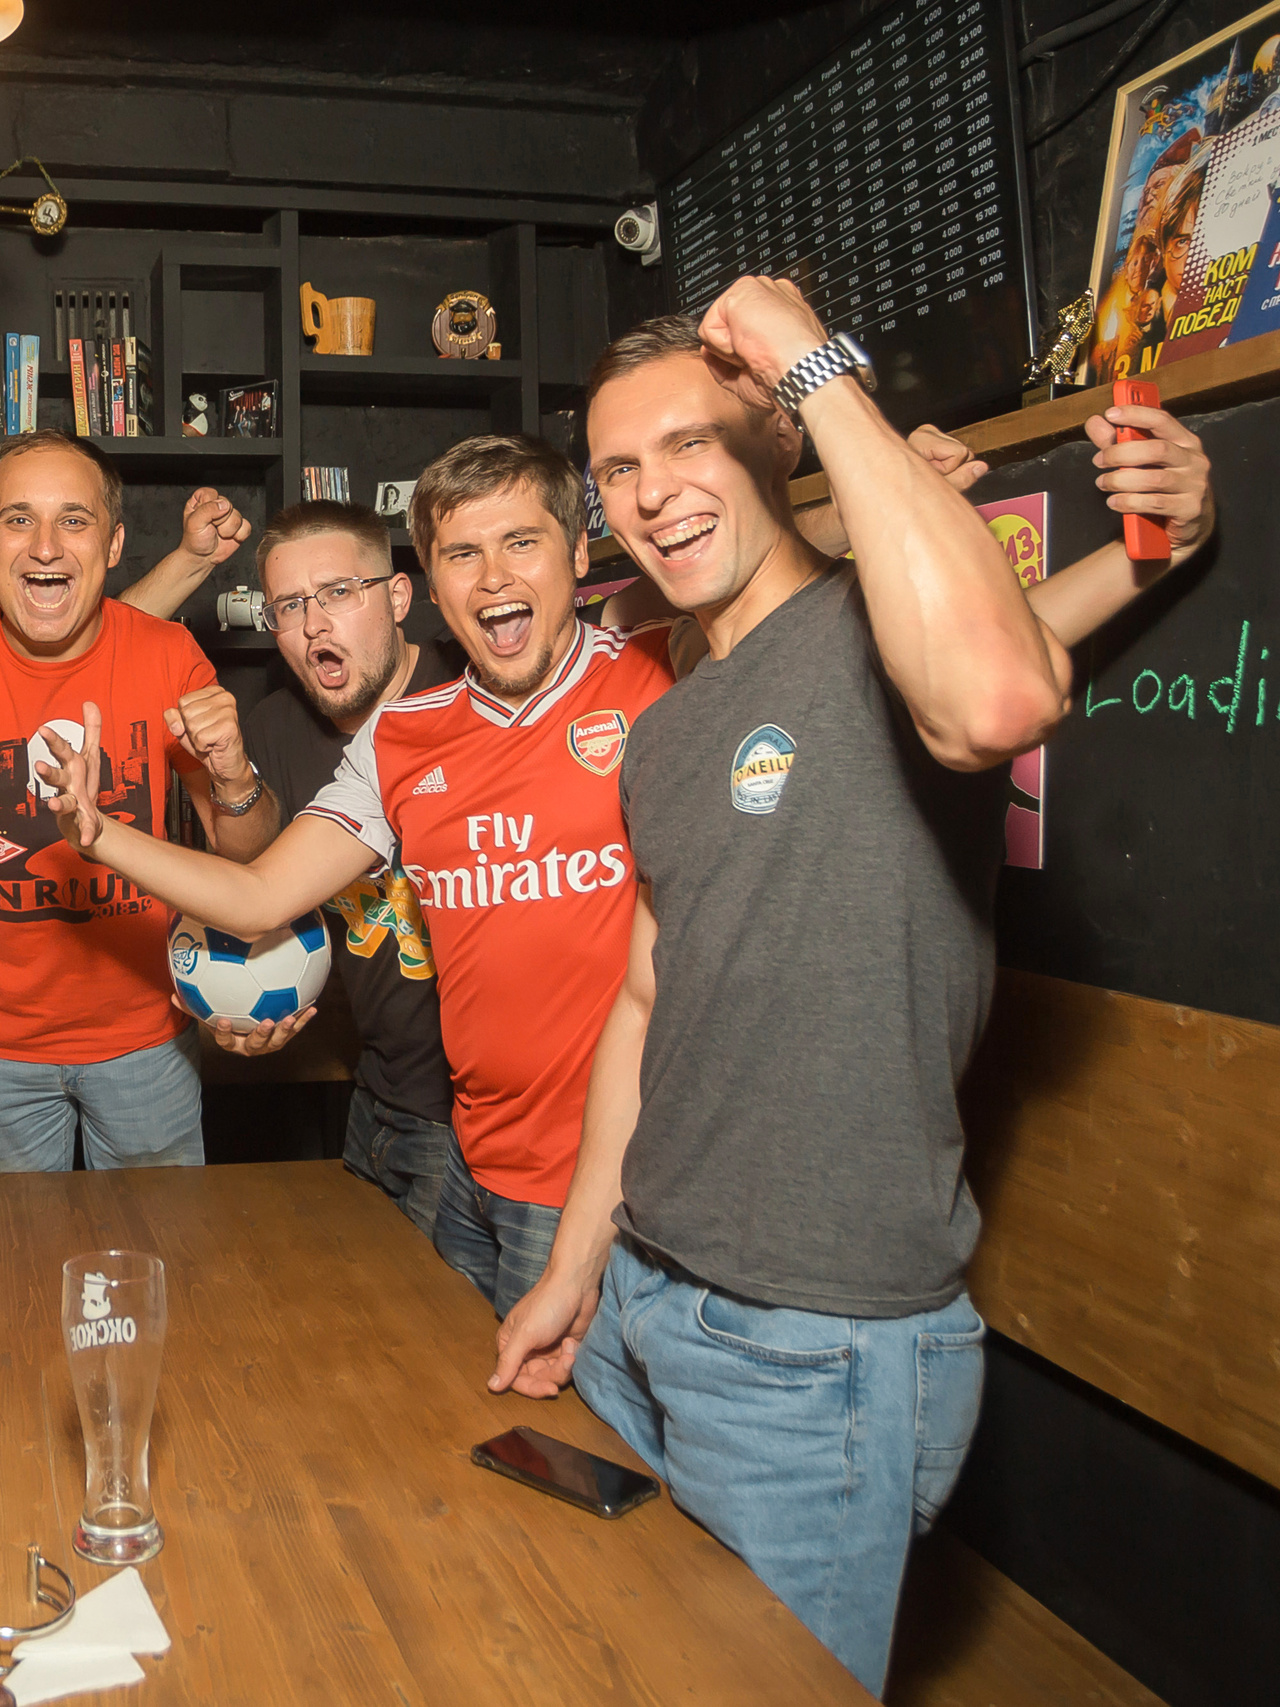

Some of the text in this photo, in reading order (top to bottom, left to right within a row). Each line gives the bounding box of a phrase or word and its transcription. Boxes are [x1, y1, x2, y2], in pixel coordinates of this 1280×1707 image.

[881, 16, 900, 35] Раунд
[850, 41, 868, 59] Раунд
[821, 65, 837, 82] Раунд
[793, 87, 808, 103] Раунд
[802, 101, 814, 114] -100
[810, 120, 815, 130] 0
[1251, 125, 1280, 147] 1 МЕС
[812, 139, 817, 148] 0
[902, 137, 915, 152] 800
[806, 158, 818, 171] -300
[809, 176, 820, 190] 200
[811, 195, 822, 207] 400
[811, 214, 824, 227] -300
[909, 220, 922, 234] 300
[814, 232, 825, 244] 400
[911, 241, 924, 255] 600
[821, 251, 827, 261] 0
[852, 254, 858, 264] 0
[789, 267, 799, 278] 900
[818, 270, 828, 283] 200
[848, 274, 859, 287] 500
[825, 289, 830, 298] 0
[915, 283, 928, 296] 300
[849, 294, 861, 306] 500
[826, 308, 832, 317] 0
[916, 304, 930, 317] 900
[851, 313, 863, 325] 500
[1169, 295, 1243, 340] ПОБЕД
[859, 333, 864, 342] 0
[73, 363, 83, 394] ГАРИН
[1085, 619, 1280, 734] Loadi
[575, 718, 618, 738] Arsenal
[412, 783, 448, 795] adidas
[466, 812, 535, 853] Fly
[402, 843, 627, 910] Emirates
[89, 897, 153, 919] 2018-19
